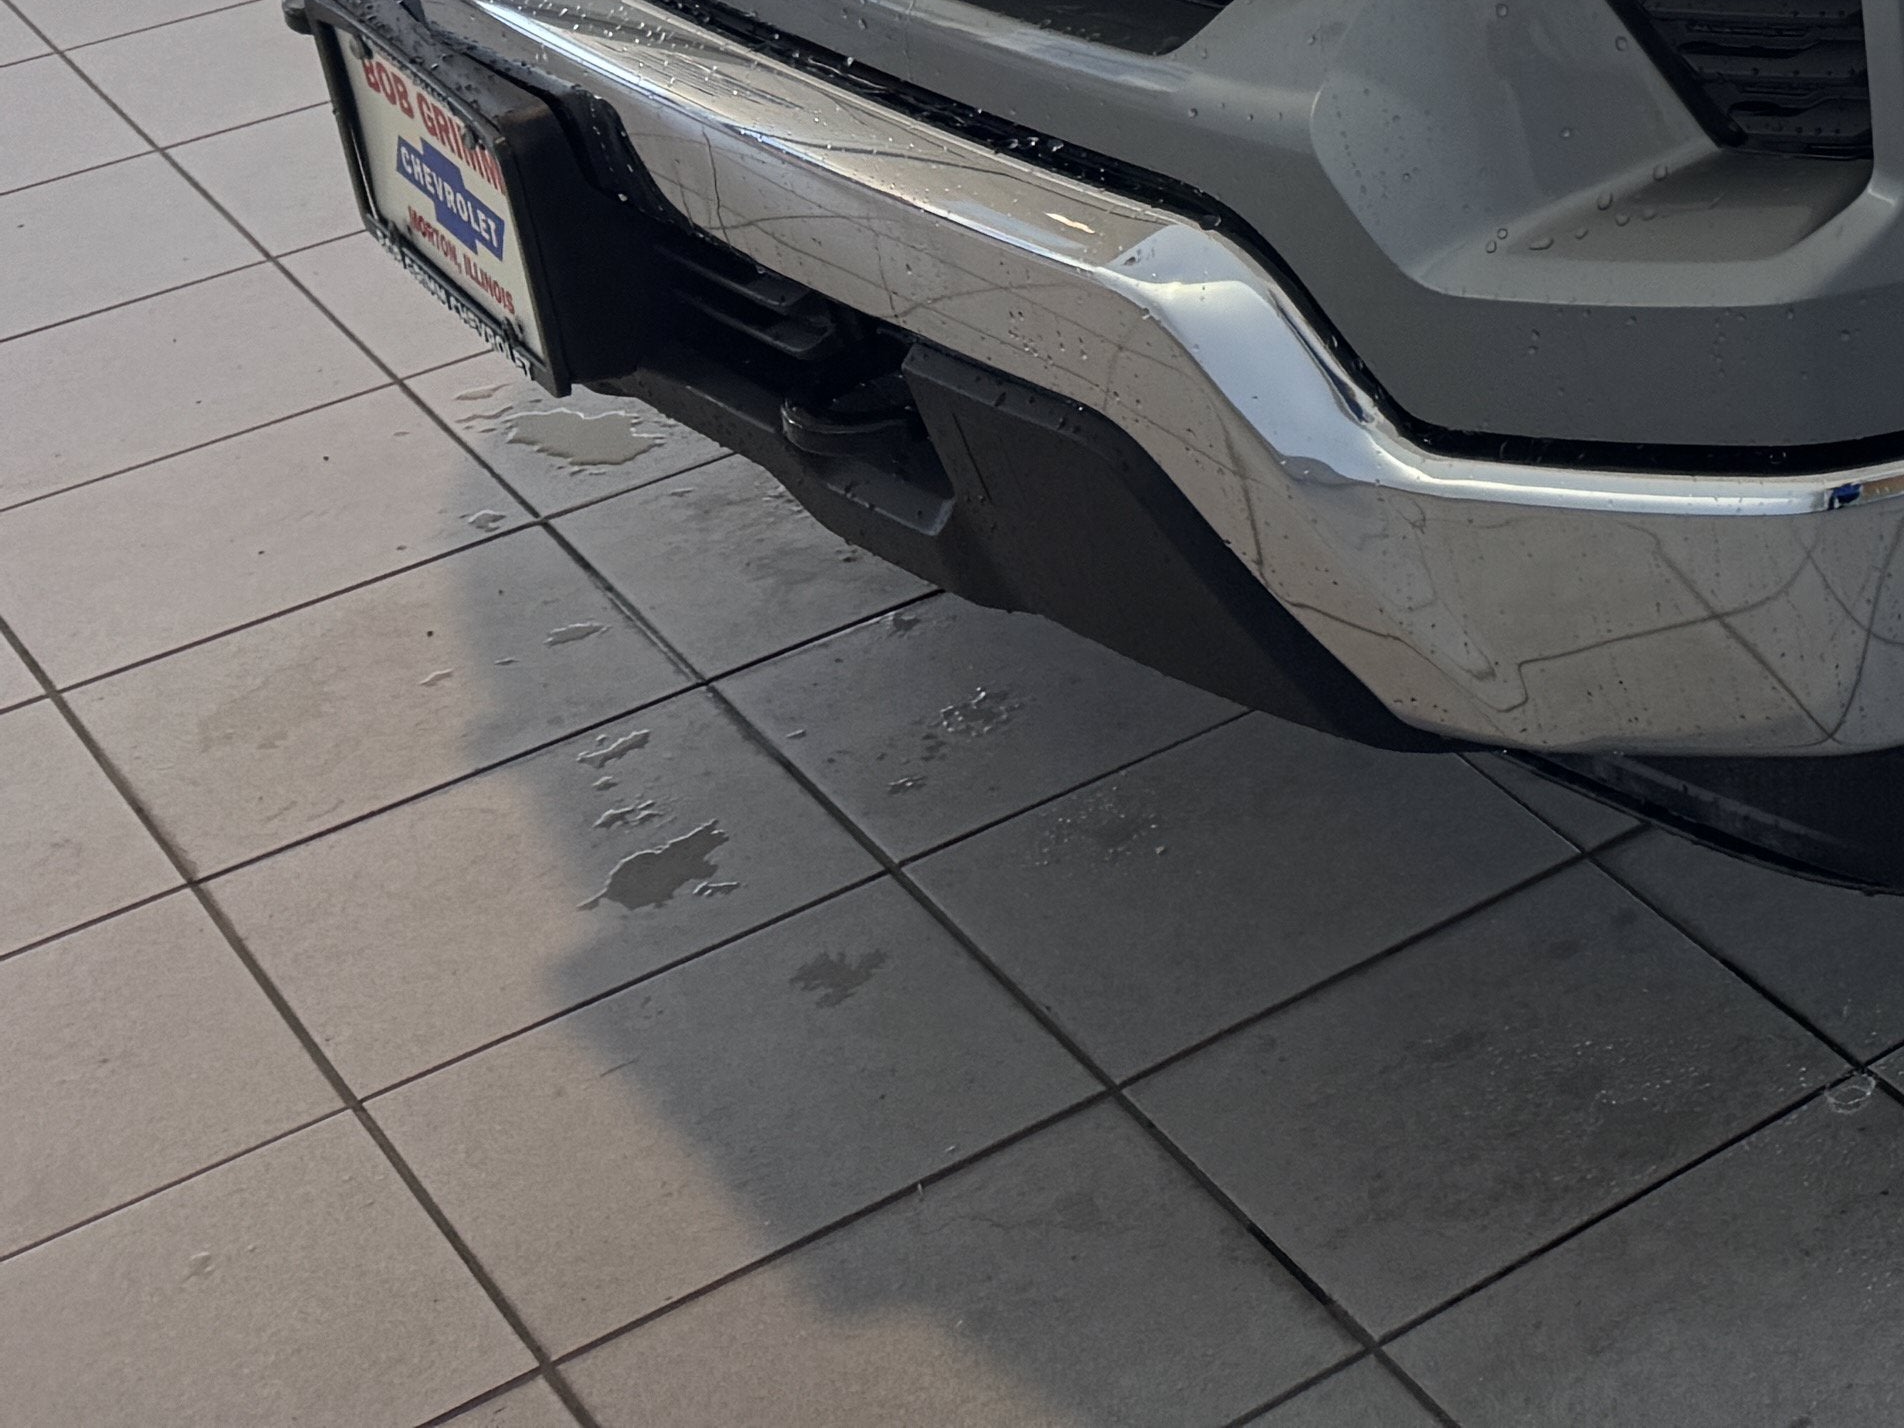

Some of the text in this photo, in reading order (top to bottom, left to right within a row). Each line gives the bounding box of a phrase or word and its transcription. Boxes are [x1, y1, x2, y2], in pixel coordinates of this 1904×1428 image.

[362, 59, 415, 119] BOB
[400, 145, 498, 248] CHEVROLET
[463, 253, 515, 316] ILLINOIS
